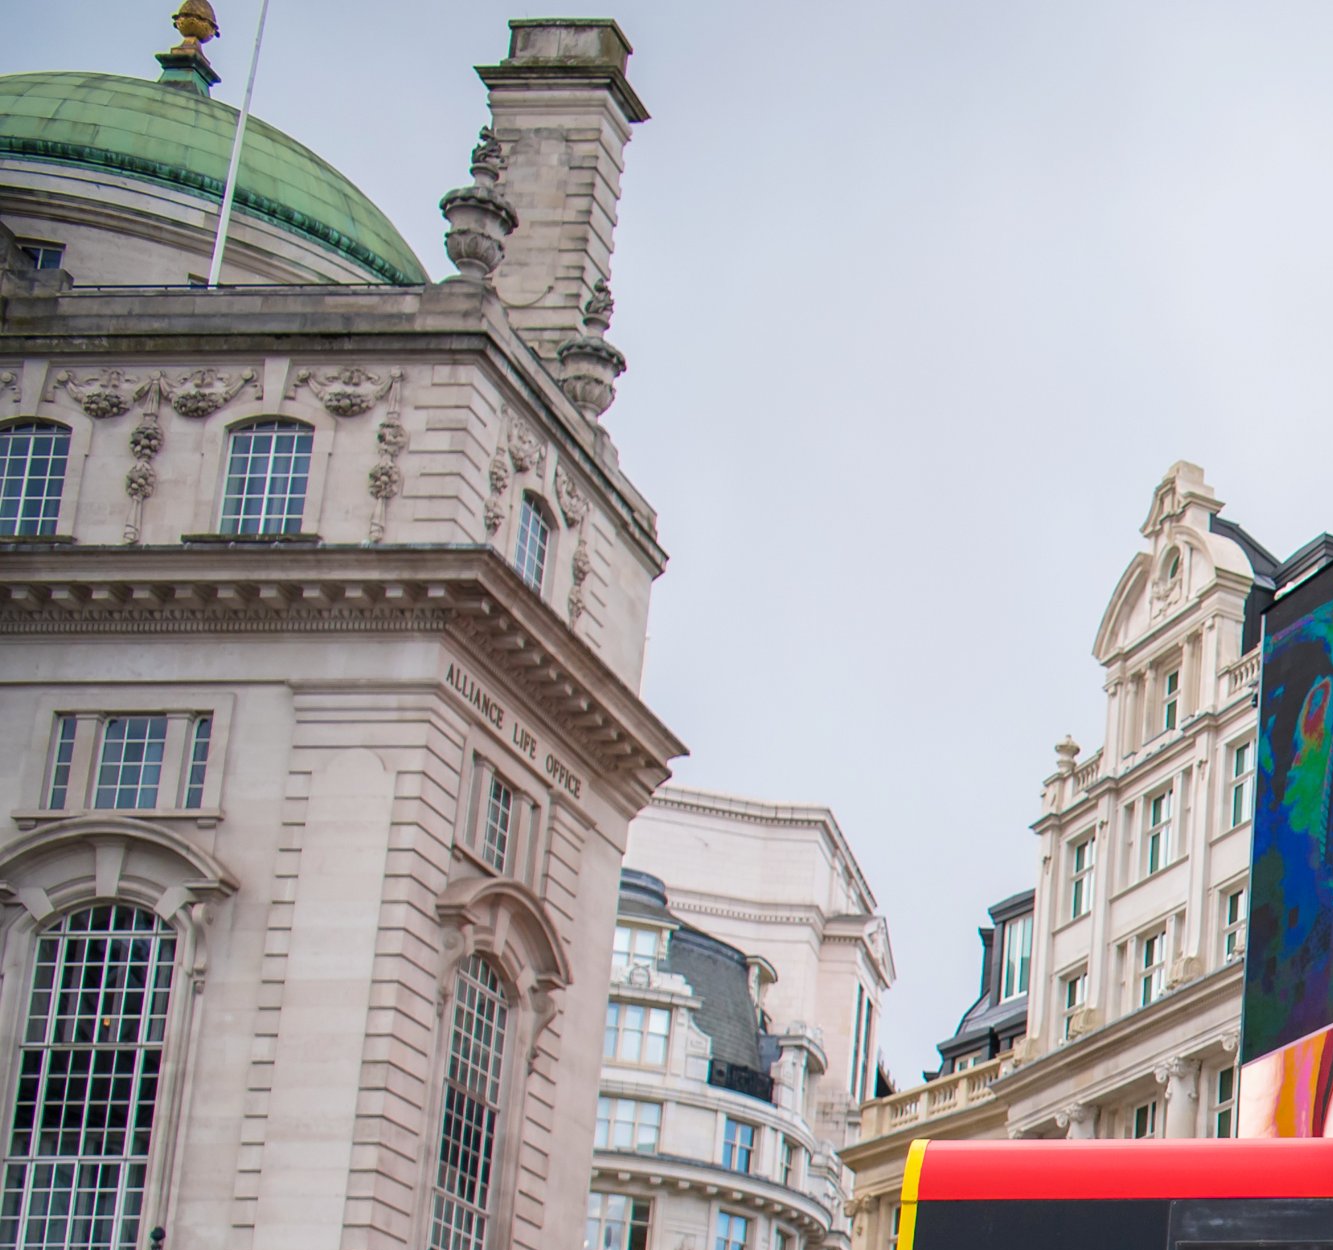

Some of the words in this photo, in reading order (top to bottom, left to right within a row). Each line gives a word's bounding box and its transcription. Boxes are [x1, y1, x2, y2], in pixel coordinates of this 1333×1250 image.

[446, 662, 504, 731] ALLIANCE
[512, 721, 537, 761] LIFE
[545, 753, 582, 799] OFFICE
